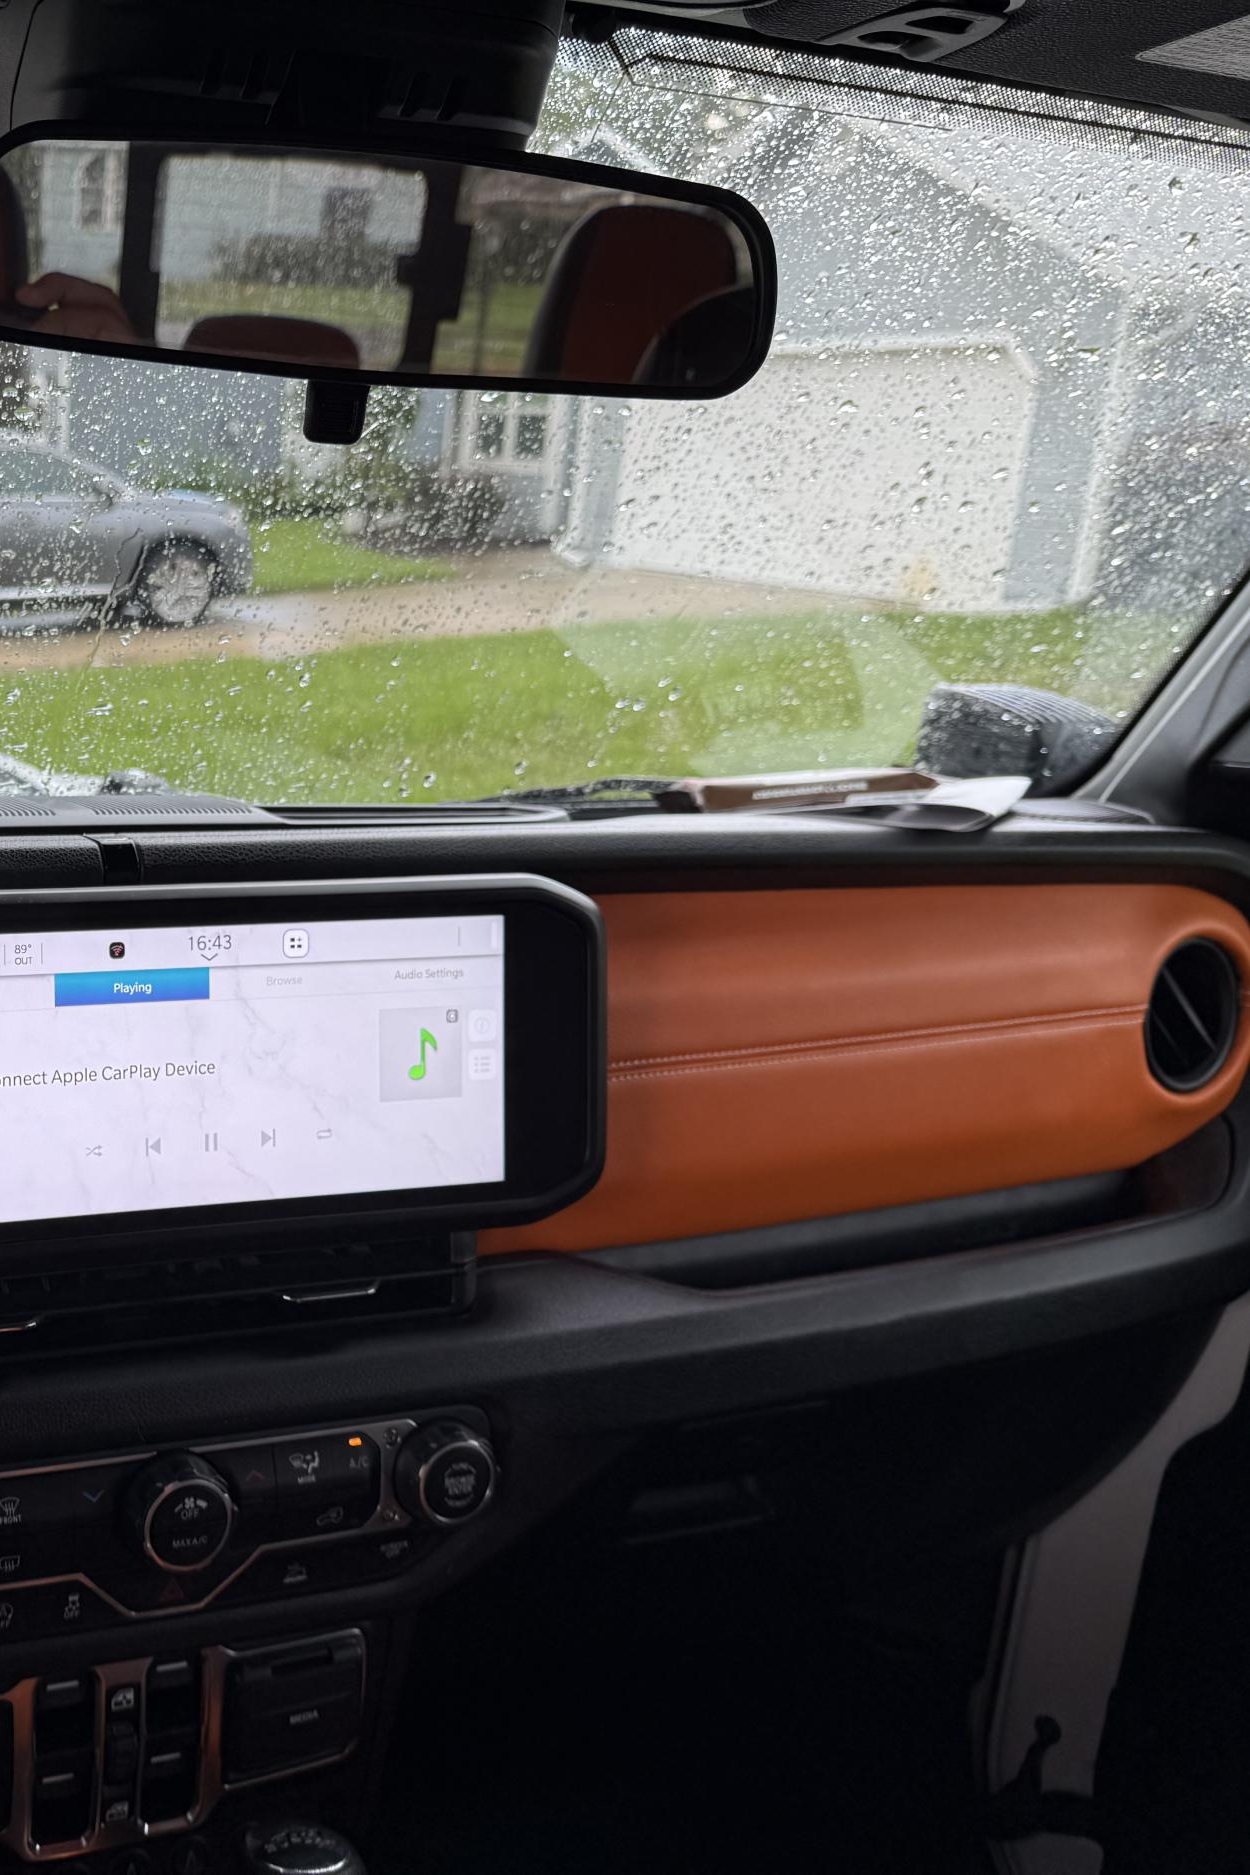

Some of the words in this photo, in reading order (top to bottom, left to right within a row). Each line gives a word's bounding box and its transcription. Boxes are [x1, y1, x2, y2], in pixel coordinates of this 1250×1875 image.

[188, 935, 232, 951] 16:43
[14, 955, 33, 966] OUT
[394, 968, 423, 980] Audio
[425, 967, 464, 980] Settings
[266, 975, 303, 986] Browse
[113, 981, 152, 995] Playing
[51, 1068, 98, 1088] Apple
[101, 1064, 161, 1082] CarPlay
[165, 1060, 216, 1077] Device
[349, 1455, 369, 1469] A/C
[0, 1514, 22, 1526] FRONT
[180, 1508, 199, 1521] OFF
[289, 1709, 319, 1725] MEDIA
